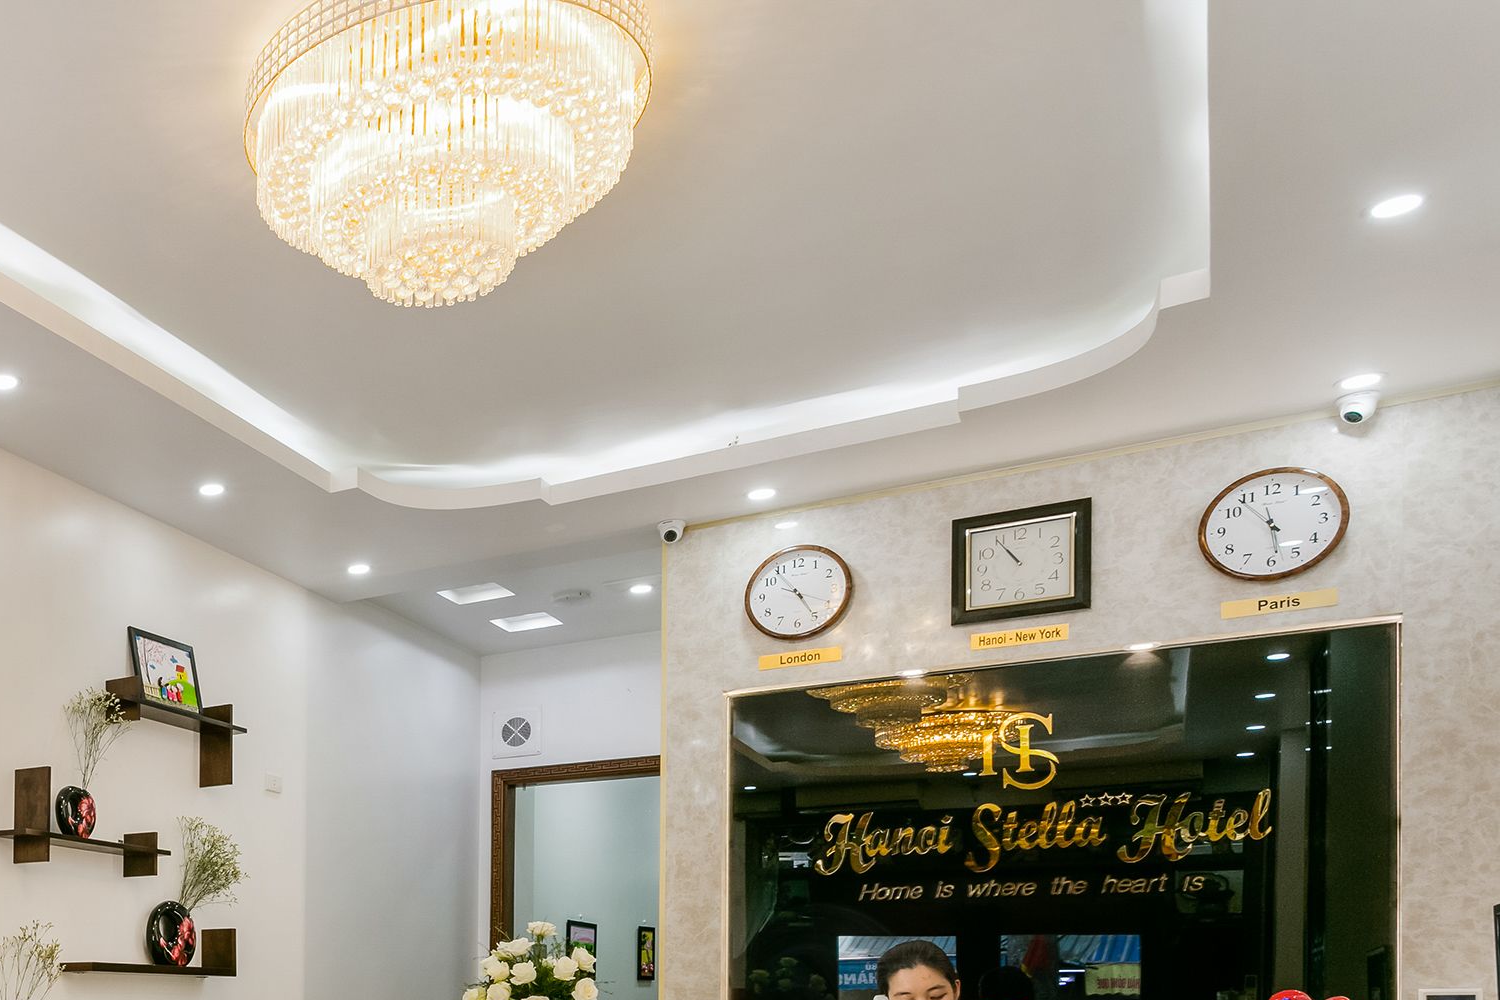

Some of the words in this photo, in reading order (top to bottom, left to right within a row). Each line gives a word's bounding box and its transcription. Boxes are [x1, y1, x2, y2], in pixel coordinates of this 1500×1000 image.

[1264, 483, 1281, 496] 12
[1240, 492, 1254, 503] 11
[1311, 495, 1321, 506] 2
[1226, 506, 1242, 519] 10
[1319, 512, 1328, 524] 3
[1013, 527, 1027, 541] 12
[1217, 527, 1226, 538] 9
[1309, 532, 1318, 543] 4
[995, 535, 1005, 546] 11
[1050, 536, 1060, 548] 2
[979, 548, 995, 560] 10
[1225, 543, 1234, 555] 8
[1291, 546, 1300, 559] 5
[792, 558, 805, 569] 12
[1053, 552, 1064, 565] 3
[1243, 553, 1252, 565] 7
[1267, 555, 1276, 567] 6
[775, 565, 786, 575] 11
[825, 569, 833, 578] 2
[977, 565, 988, 576] 9
[1048, 569, 1059, 581] 4
[765, 577, 777, 587] 10
[981, 579, 991, 592] 8
[996, 588, 1006, 600] 7
[1014, 587, 1025, 600] 6
[1035, 583, 1045, 595] 5
[759, 594, 766, 603] 9
[1258, 597, 1300, 611] Paris
[764, 608, 772, 617] 8
[811, 612, 818, 621] 5
[777, 616, 784, 626] 7
[794, 619, 801, 628] 6
[978, 634, 1006, 647] Hanoi
[1015, 631, 1036, 642] New
[1039, 627, 1061, 640] York
[780, 652, 820, 665] London
[814, 811, 953, 876] Hanoi
[964, 800, 1108, 873] Stella
[1116, 788, 1272, 863] Hotel
[859, 883, 924, 901] Home
[935, 881, 955, 898] is
[967, 879, 1037, 897] where
[1051, 876, 1088, 896] the
[1101, 873, 1168, 894] heart
